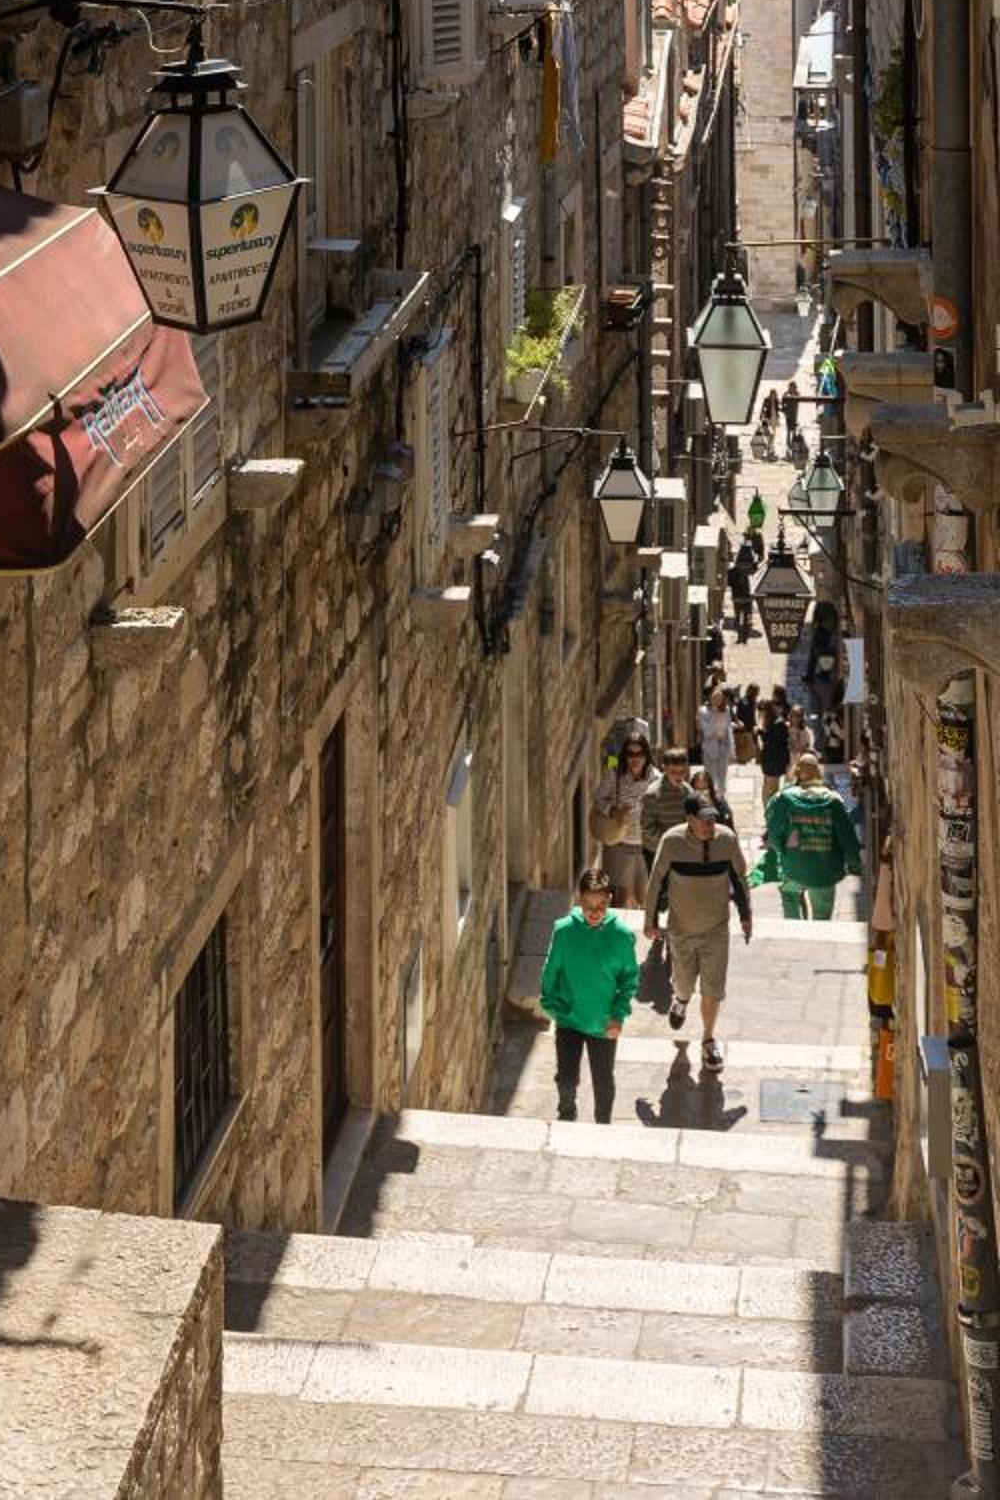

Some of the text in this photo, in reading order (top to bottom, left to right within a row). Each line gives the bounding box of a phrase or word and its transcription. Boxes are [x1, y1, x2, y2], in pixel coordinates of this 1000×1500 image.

[205, 234, 277, 260] superluxury
[209, 261, 269, 285] APARTMENTS
[771, 622, 799, 637] BAGS
